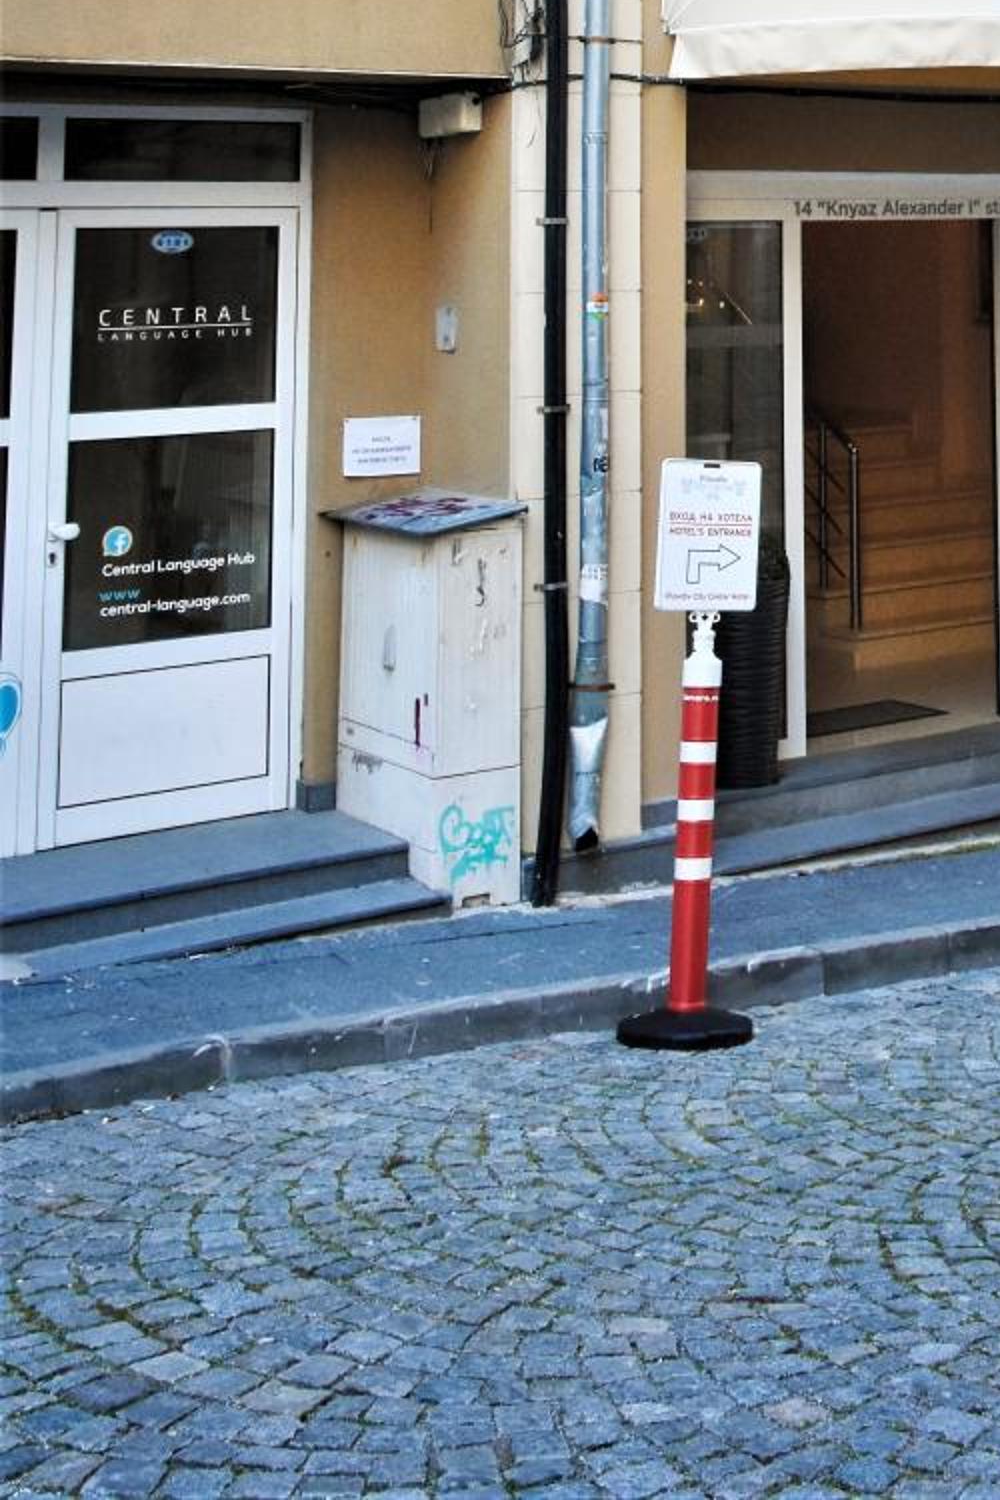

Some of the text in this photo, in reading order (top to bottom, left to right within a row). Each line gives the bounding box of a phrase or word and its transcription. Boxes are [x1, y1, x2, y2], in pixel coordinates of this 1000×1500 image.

[794, 200, 812, 217] 14
[881, 198, 964, 217] Alexander
[98, 304, 253, 327] CENTRAL
[97, 327, 253, 342] LANGUAGE HUB
[101, 552, 256, 578] Central Language Hub
[99, 588, 141, 602] www
[100, 591, 252, 618] central-language.com
